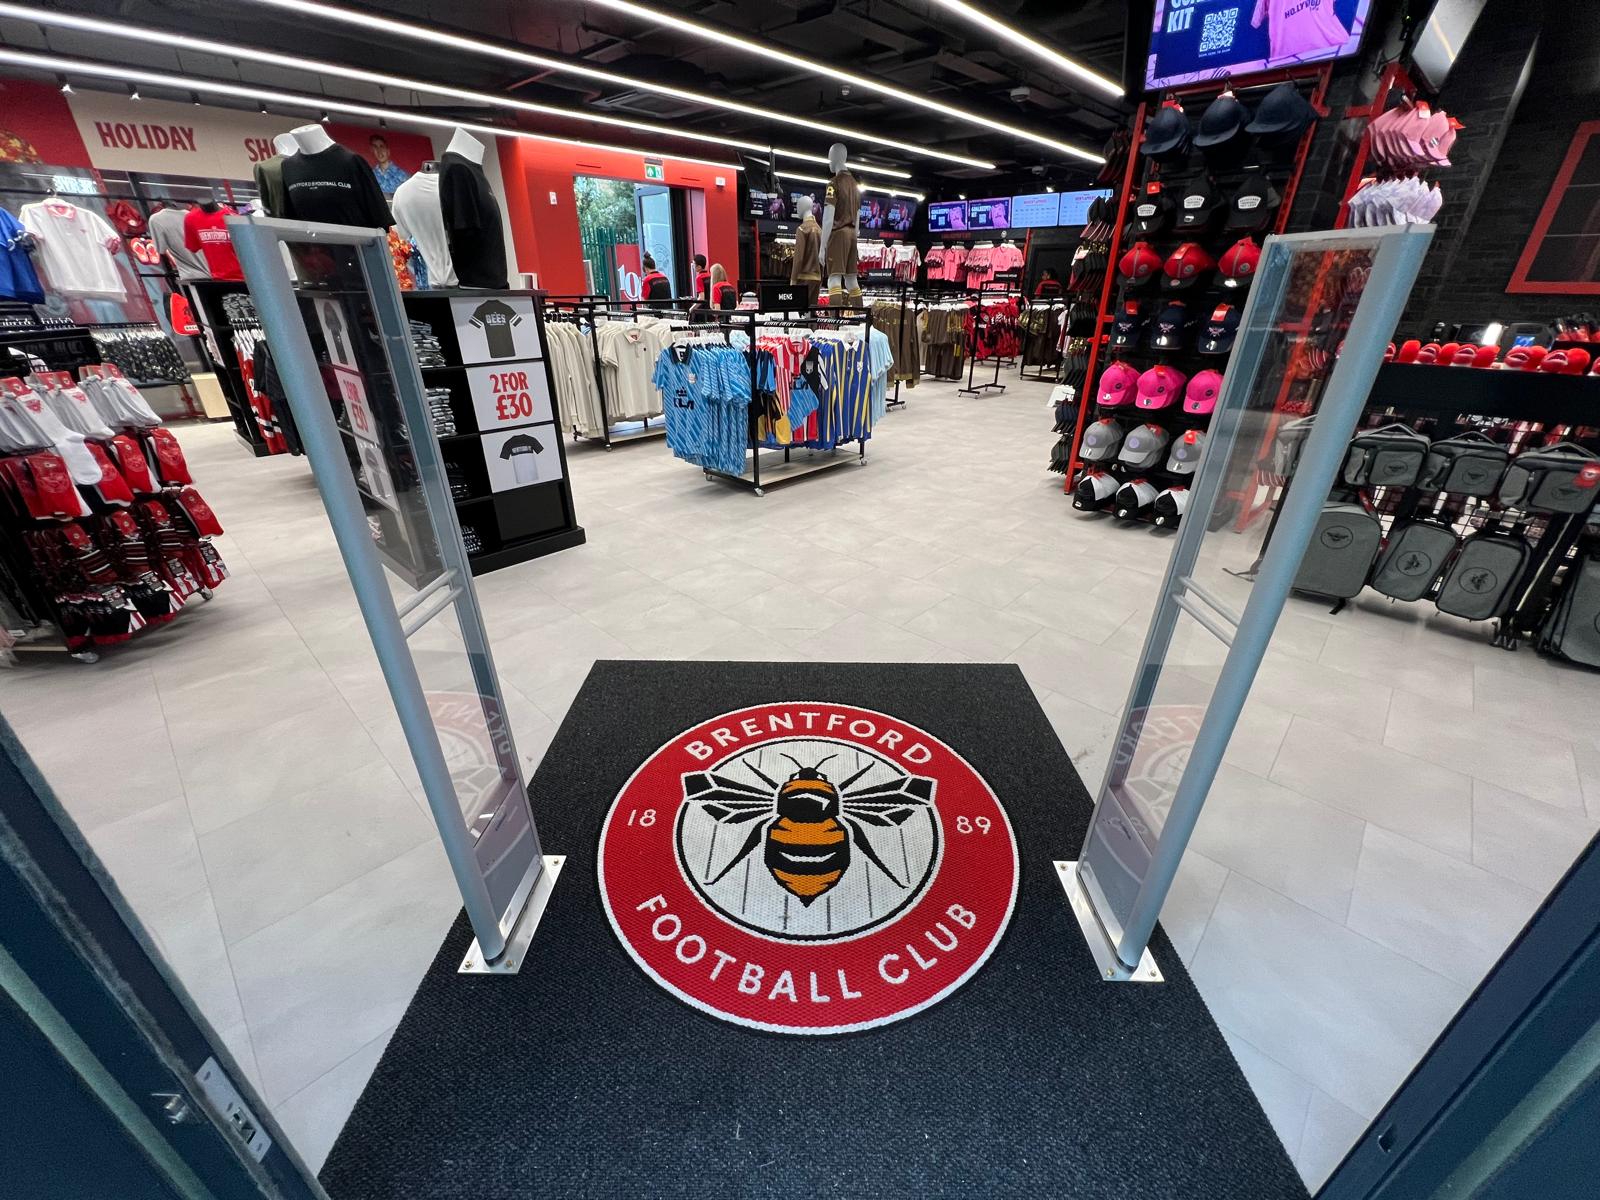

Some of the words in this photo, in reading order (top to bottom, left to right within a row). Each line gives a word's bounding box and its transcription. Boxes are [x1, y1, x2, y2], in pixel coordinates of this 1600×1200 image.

[1167, 6, 1195, 33] KIT
[94, 121, 197, 152] HOLIDAY
[778, 293, 793, 301] MENS
[485, 313, 507, 324] BEES
[489, 374, 501, 393] 2
[500, 371, 529, 392] FOR
[496, 392, 533, 421] £30
[684, 712, 932, 764] BRENTFORD
[627, 808, 657, 828] 18
[957, 816, 991, 835] 89
[636, 893, 862, 1003] FOOTBALL
[878, 903, 977, 985] CLUB
